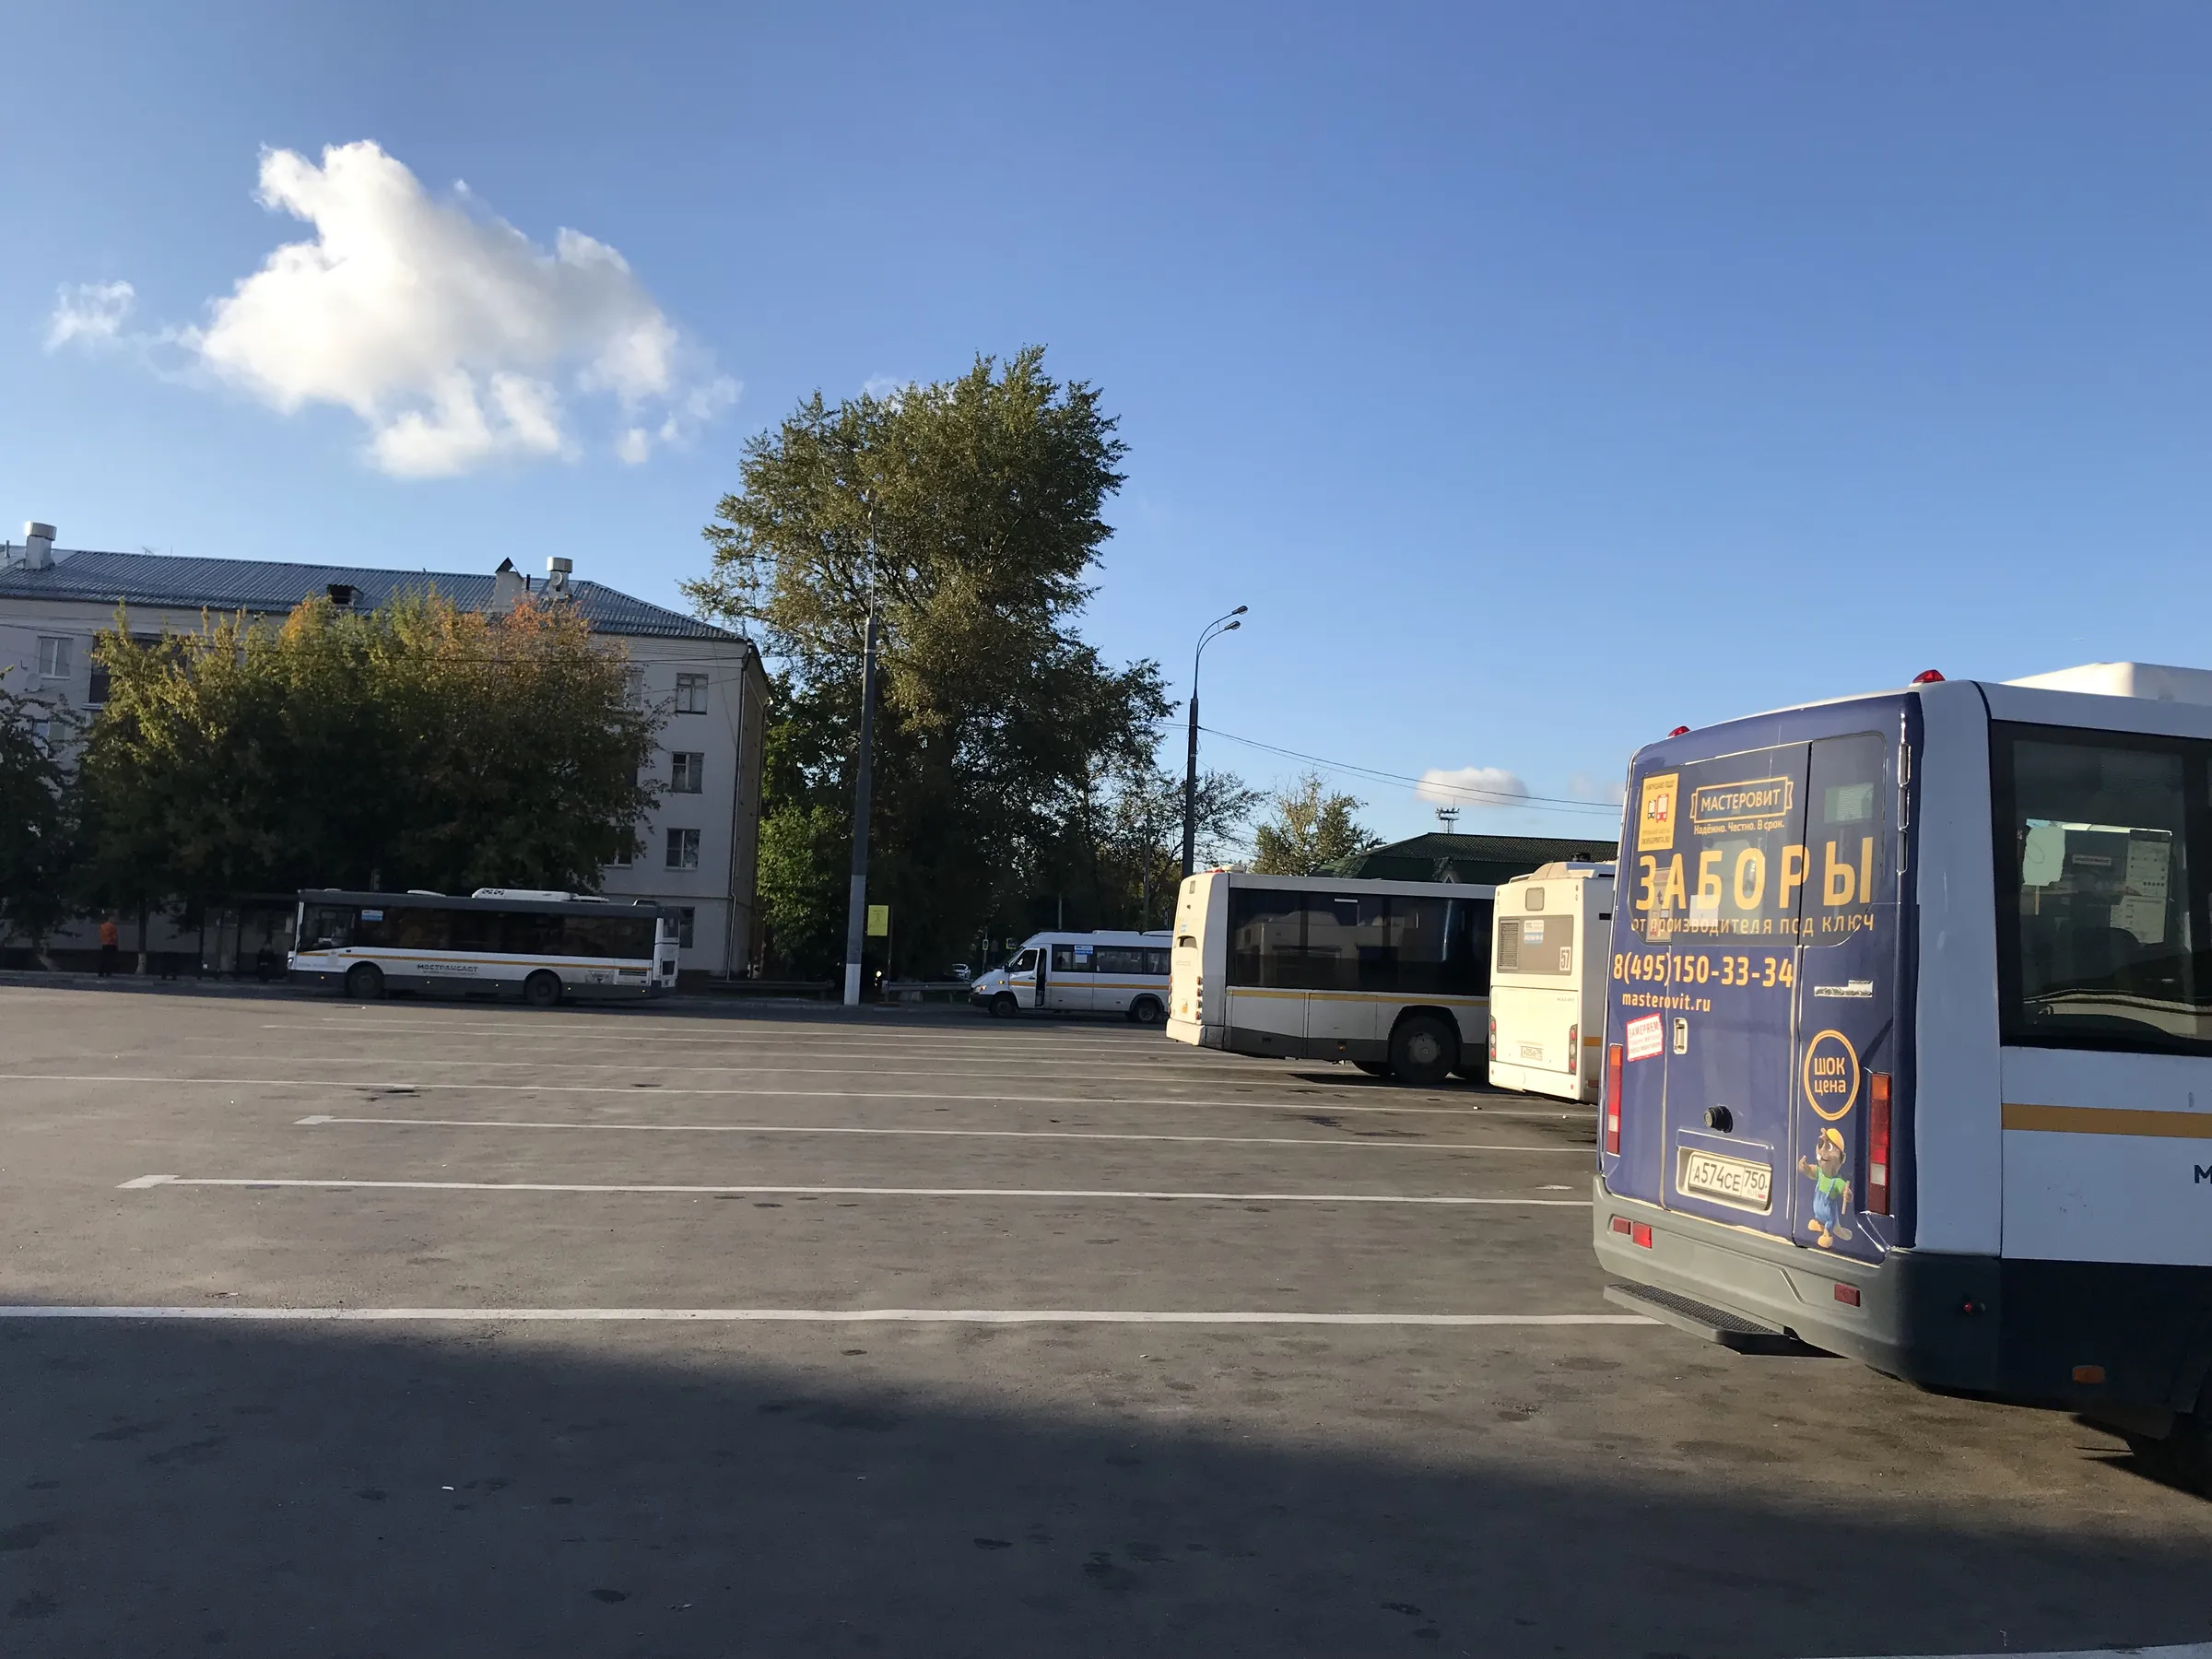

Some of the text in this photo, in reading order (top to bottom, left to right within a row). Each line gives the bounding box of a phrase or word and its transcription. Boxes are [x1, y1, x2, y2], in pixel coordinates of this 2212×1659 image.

[1700, 789, 1781, 812] МАСТЕРОВИТ
[1728, 821, 1756, 832] Честно.
[1758, 819, 1763, 830] В
[1764, 819, 1784, 831] срок.
[1636, 837, 1873, 911] ЗАБОРЫ
[1631, 913, 1874, 937] от производителя под ключ
[1560, 949, 1570, 969] 57
[1613, 951, 1794, 988] 8(495)150-33-34
[1622, 992, 1711, 1012] masterovit.ru
[1814, 1057, 1845, 1076] ШОК
[1814, 1079, 1846, 1096] цена
